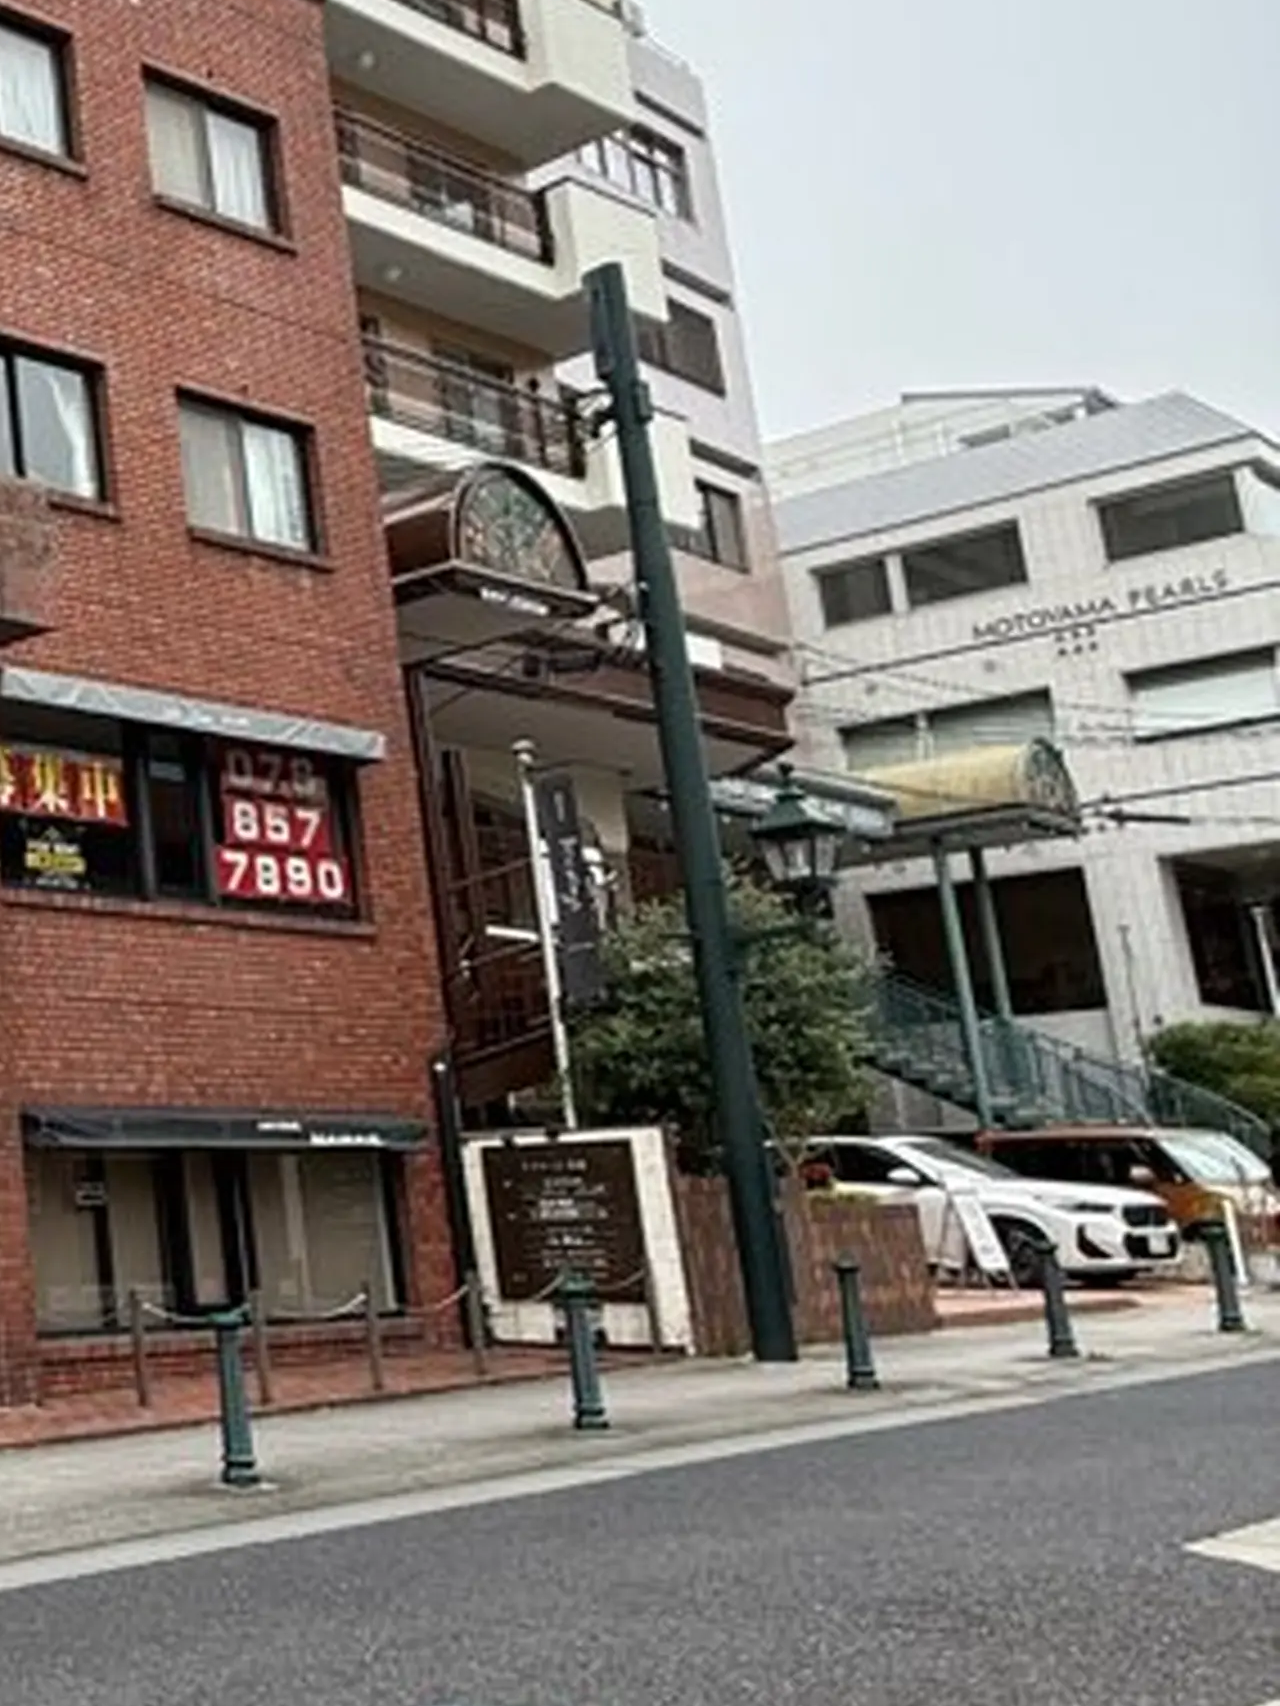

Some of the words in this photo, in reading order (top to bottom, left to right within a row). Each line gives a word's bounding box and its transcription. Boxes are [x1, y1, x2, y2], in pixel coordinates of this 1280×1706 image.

[972, 596, 1116, 640] MOTOYAMA
[1127, 568, 1230, 606] PEARLS
[221, 849, 344, 898] 7890
